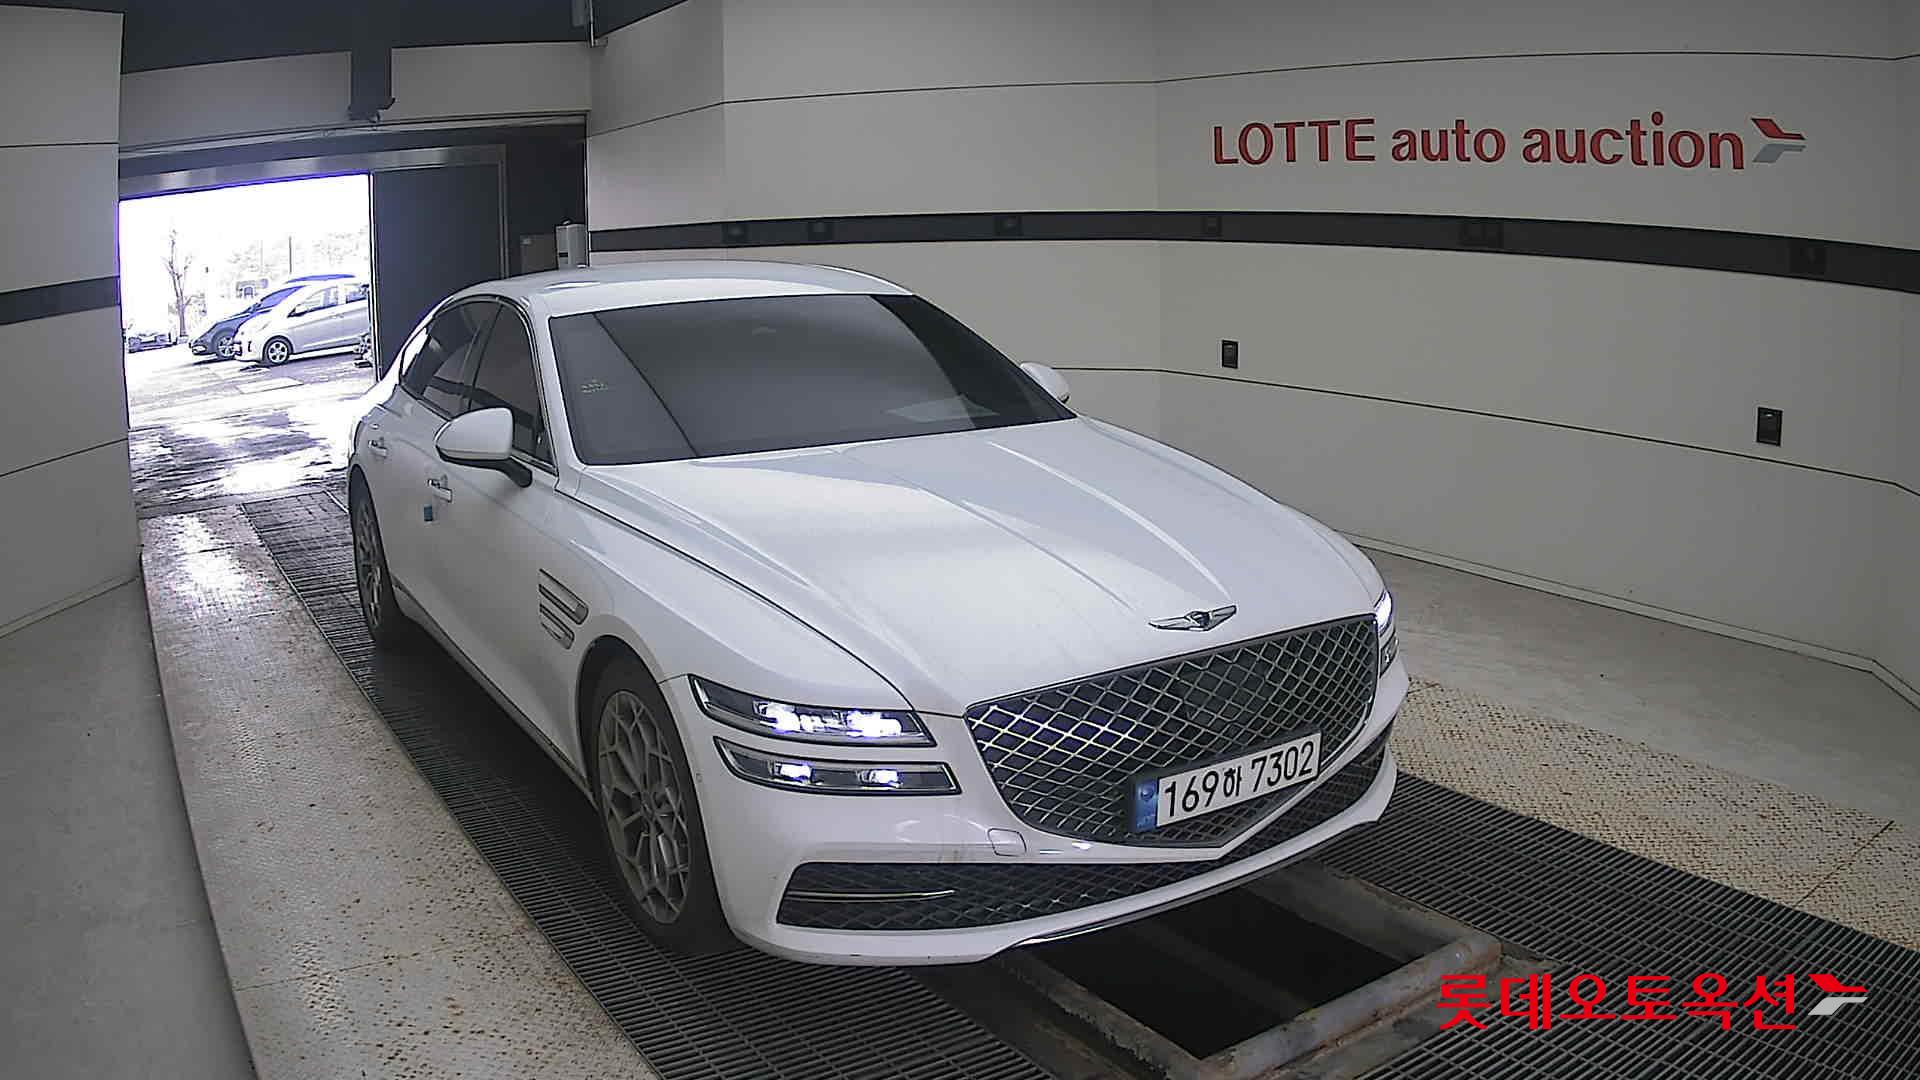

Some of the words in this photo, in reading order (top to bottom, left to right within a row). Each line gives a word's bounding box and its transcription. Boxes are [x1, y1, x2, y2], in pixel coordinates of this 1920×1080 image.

[1213, 118, 1376, 165] LOTTE
[1391, 119, 1507, 163] auto
[1522, 111, 1745, 170] auction
[1164, 766, 1242, 817] 169하
[1251, 741, 1314, 792] 7302
